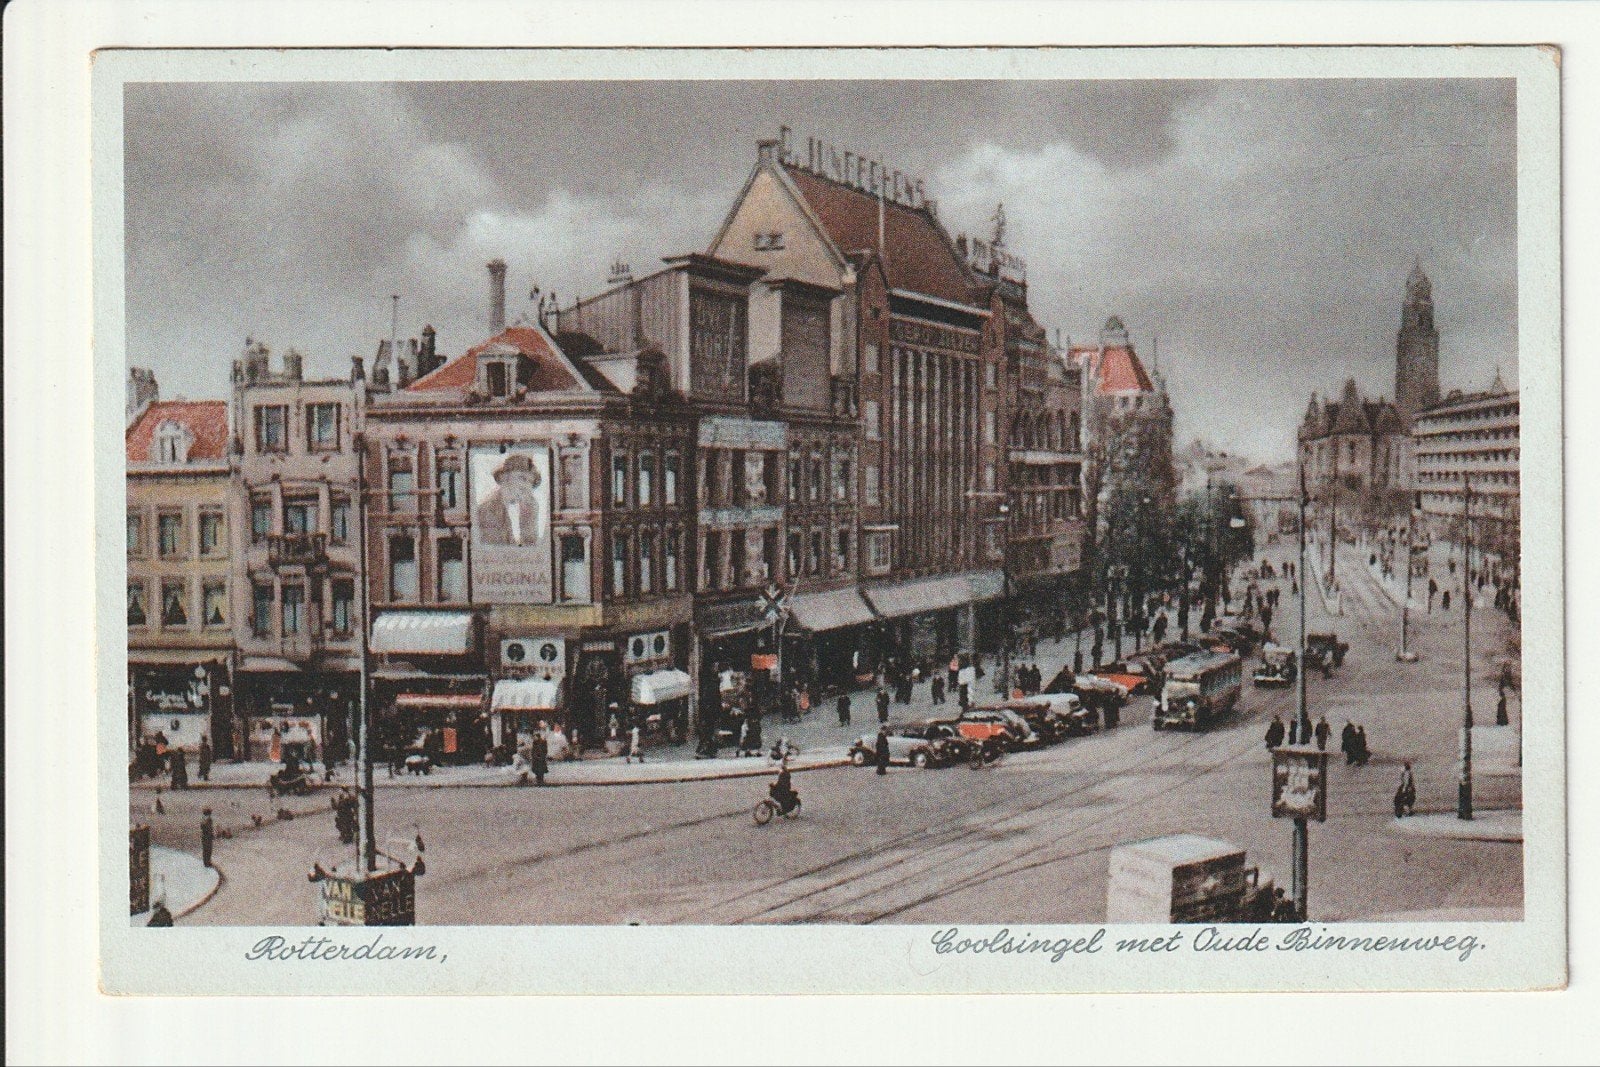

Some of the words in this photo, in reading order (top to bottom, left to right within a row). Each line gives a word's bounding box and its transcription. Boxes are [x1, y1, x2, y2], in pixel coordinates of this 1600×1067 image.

[475, 572, 548, 585] VIRGINIA
[322, 879, 352, 900] VAN
[371, 880, 401, 901] VAN
[371, 894, 413, 920] NELLE
